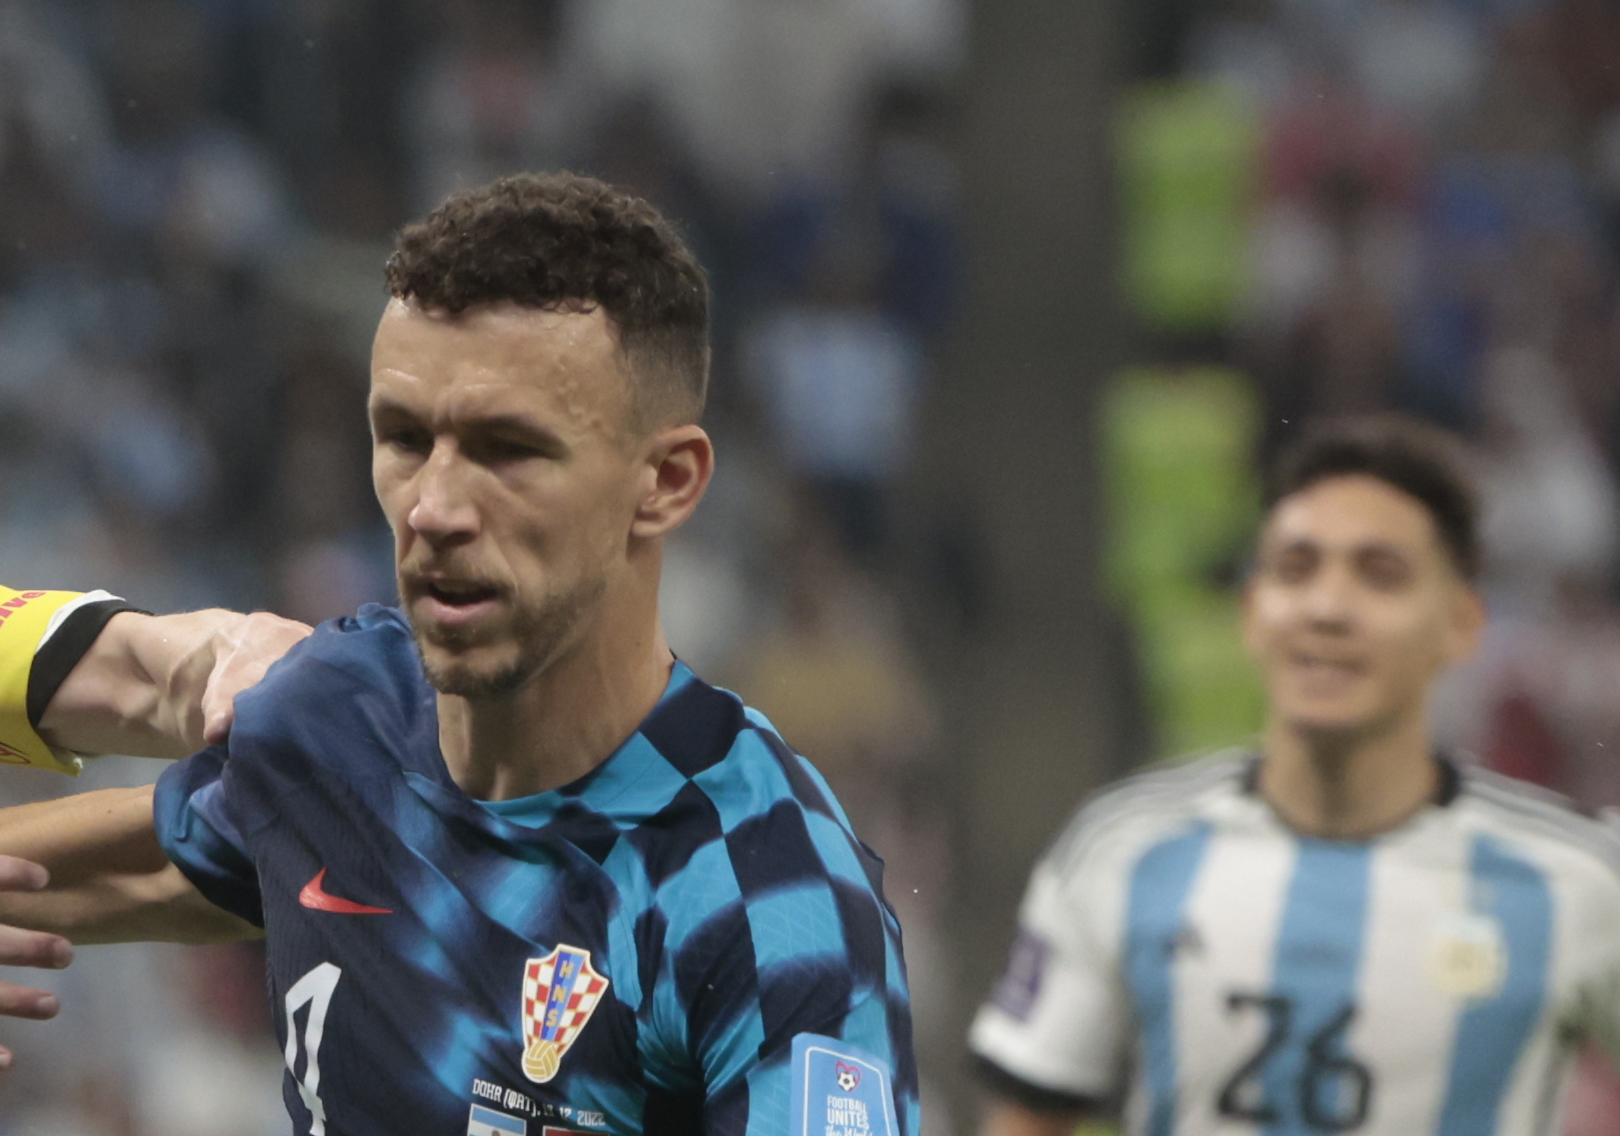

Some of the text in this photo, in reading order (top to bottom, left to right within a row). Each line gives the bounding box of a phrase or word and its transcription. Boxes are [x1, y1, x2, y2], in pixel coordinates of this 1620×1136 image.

[546, 959, 574, 1028] HNS
[1216, 988, 1372, 1135] 26
[827, 1095, 866, 1113] FOOTBALL
[827, 1108, 870, 1130] UNITES
